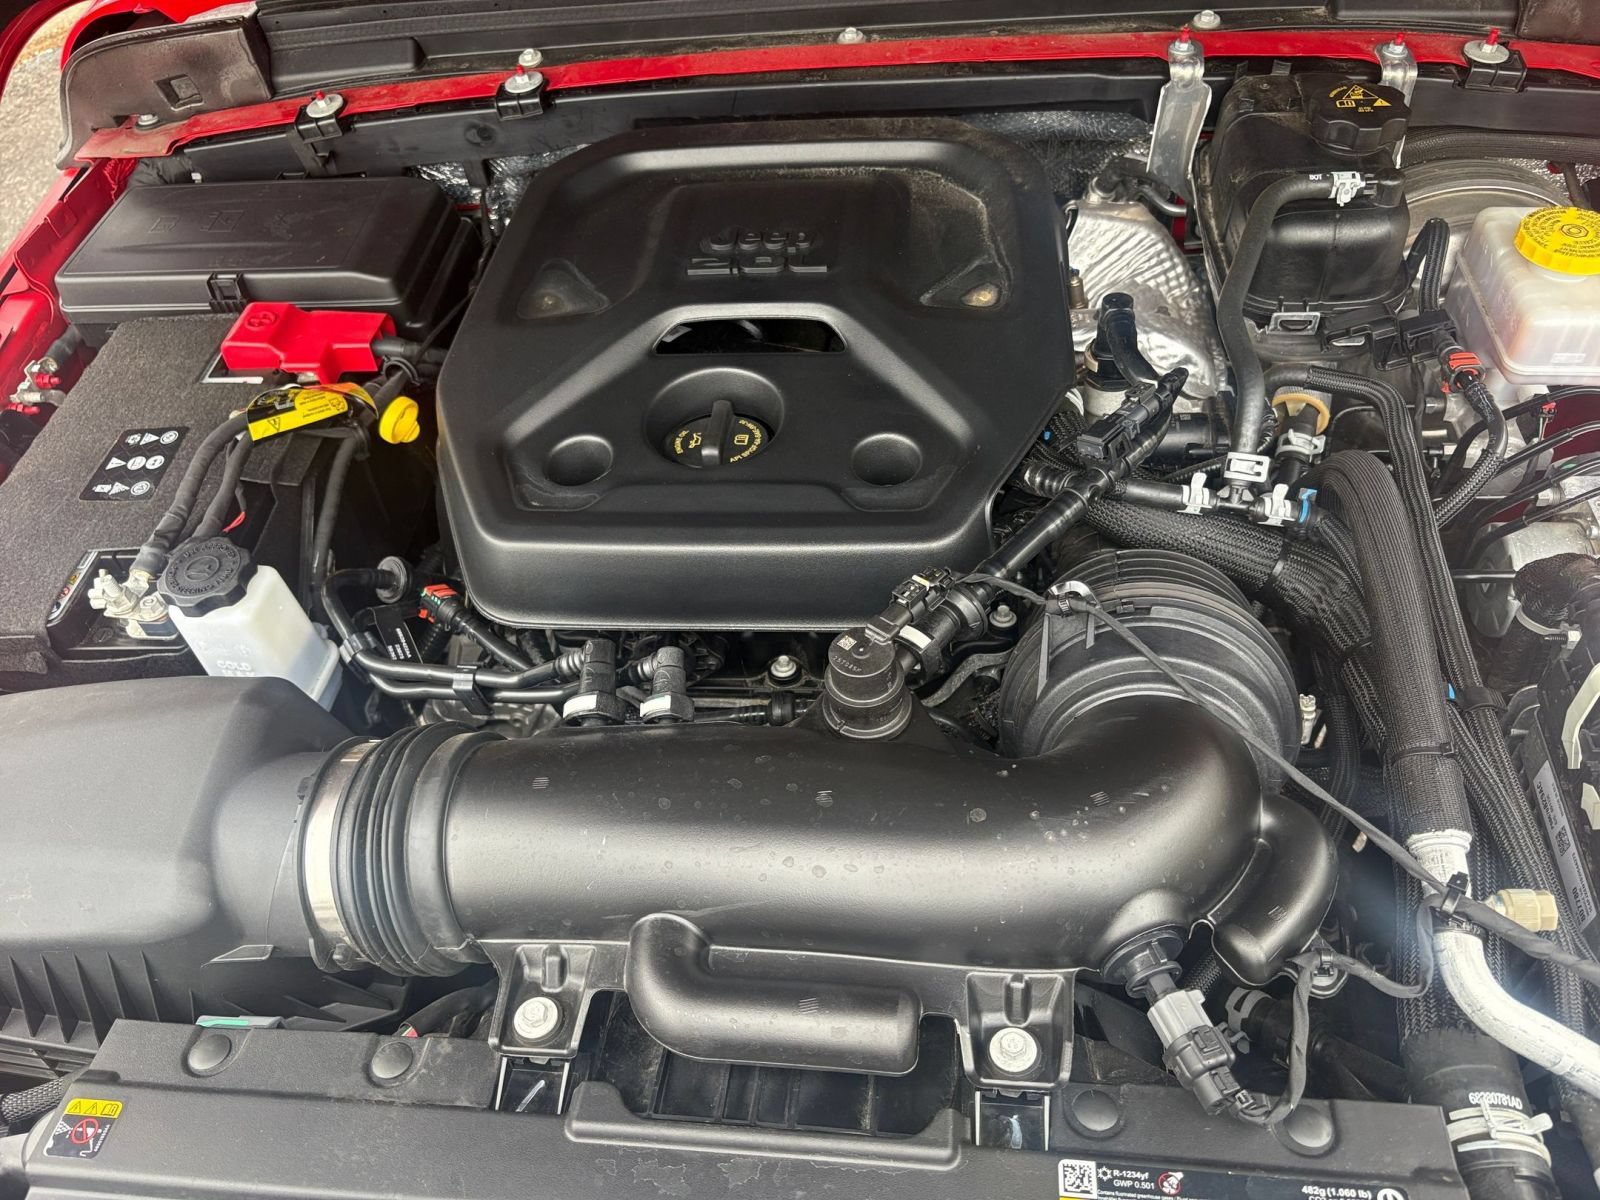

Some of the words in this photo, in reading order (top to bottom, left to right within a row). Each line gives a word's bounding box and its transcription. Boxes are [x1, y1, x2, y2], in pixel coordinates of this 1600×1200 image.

[709, 228, 812, 253] Jeep
[216, 660, 252, 672] COLD
[1112, 1169, 1149, 1180] R-1234yf
[1113, 1179, 1133, 1188] GWP
[1134, 1181, 1155, 1190] 0.501
[1301, 1185, 1327, 1197] 482g
[1357, 1189, 1373, 1200] lb)
